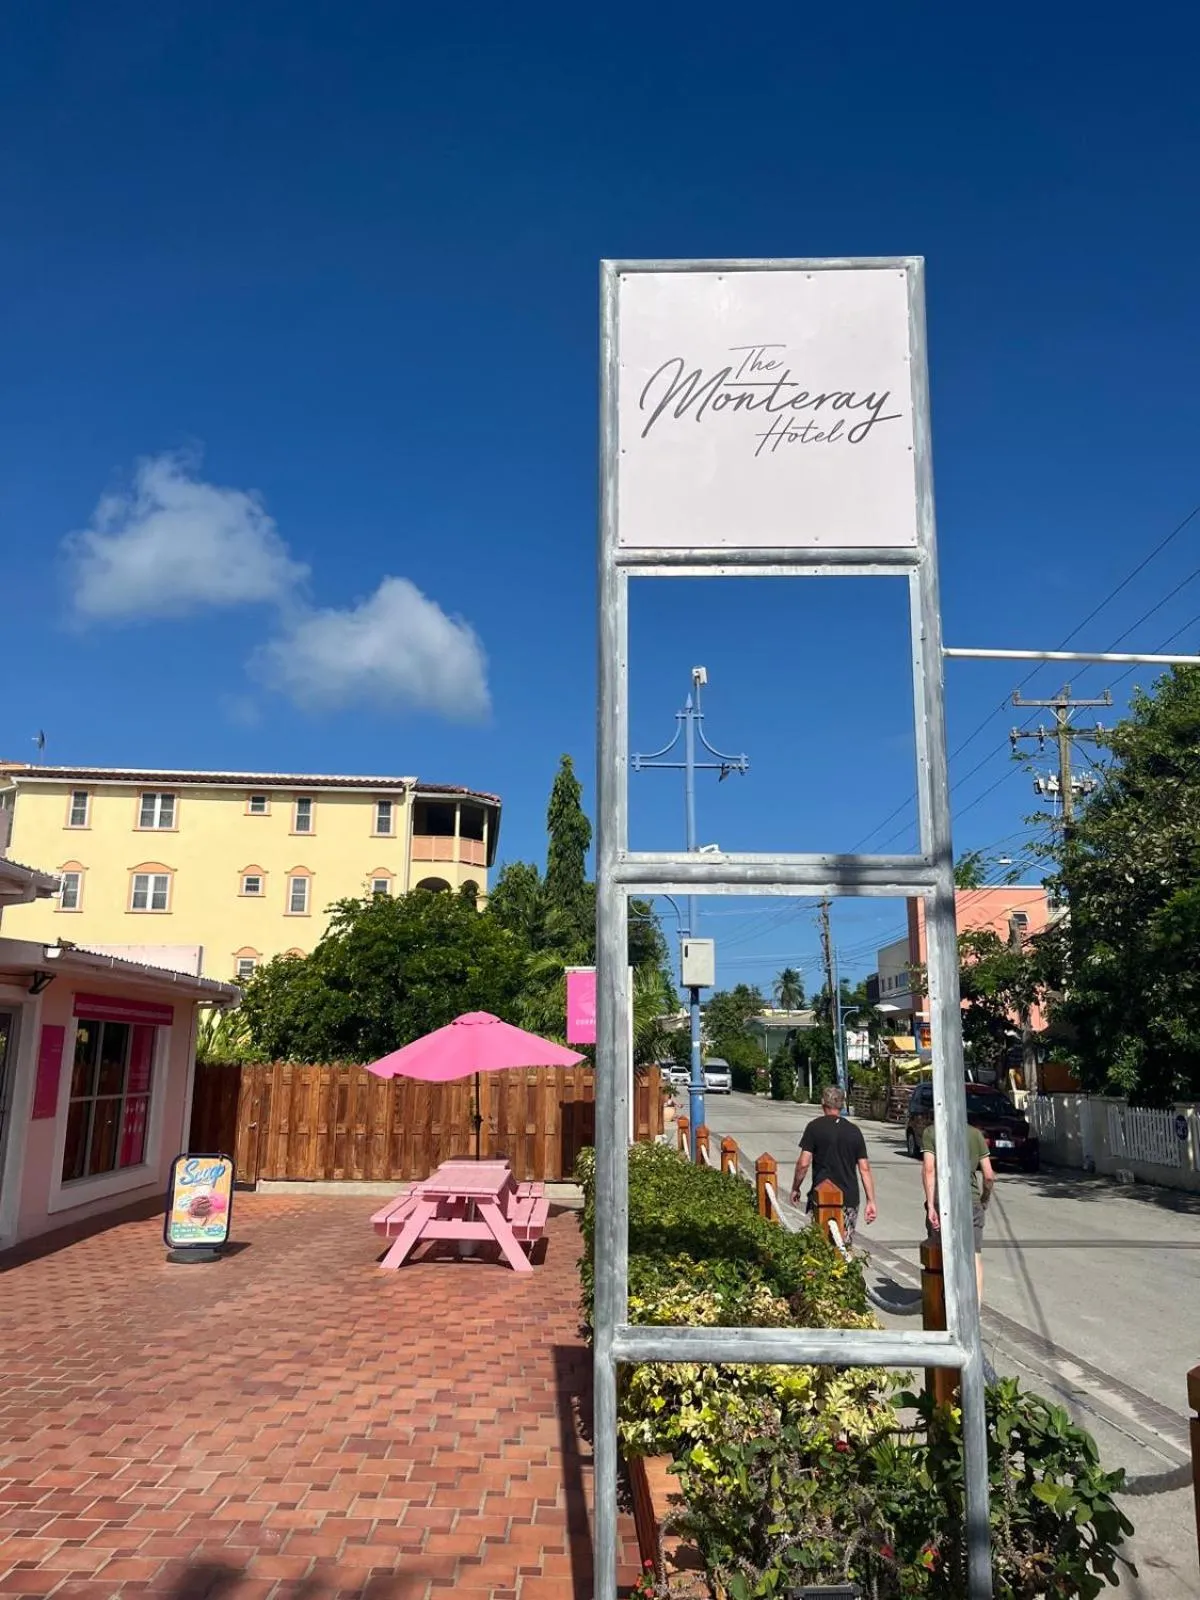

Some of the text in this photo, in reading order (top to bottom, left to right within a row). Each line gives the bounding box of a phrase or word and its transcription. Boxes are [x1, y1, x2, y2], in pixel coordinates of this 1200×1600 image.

[729, 344, 787, 379] The
[639, 357, 903, 443] Monteray
[755, 414, 845, 457] Hotel
